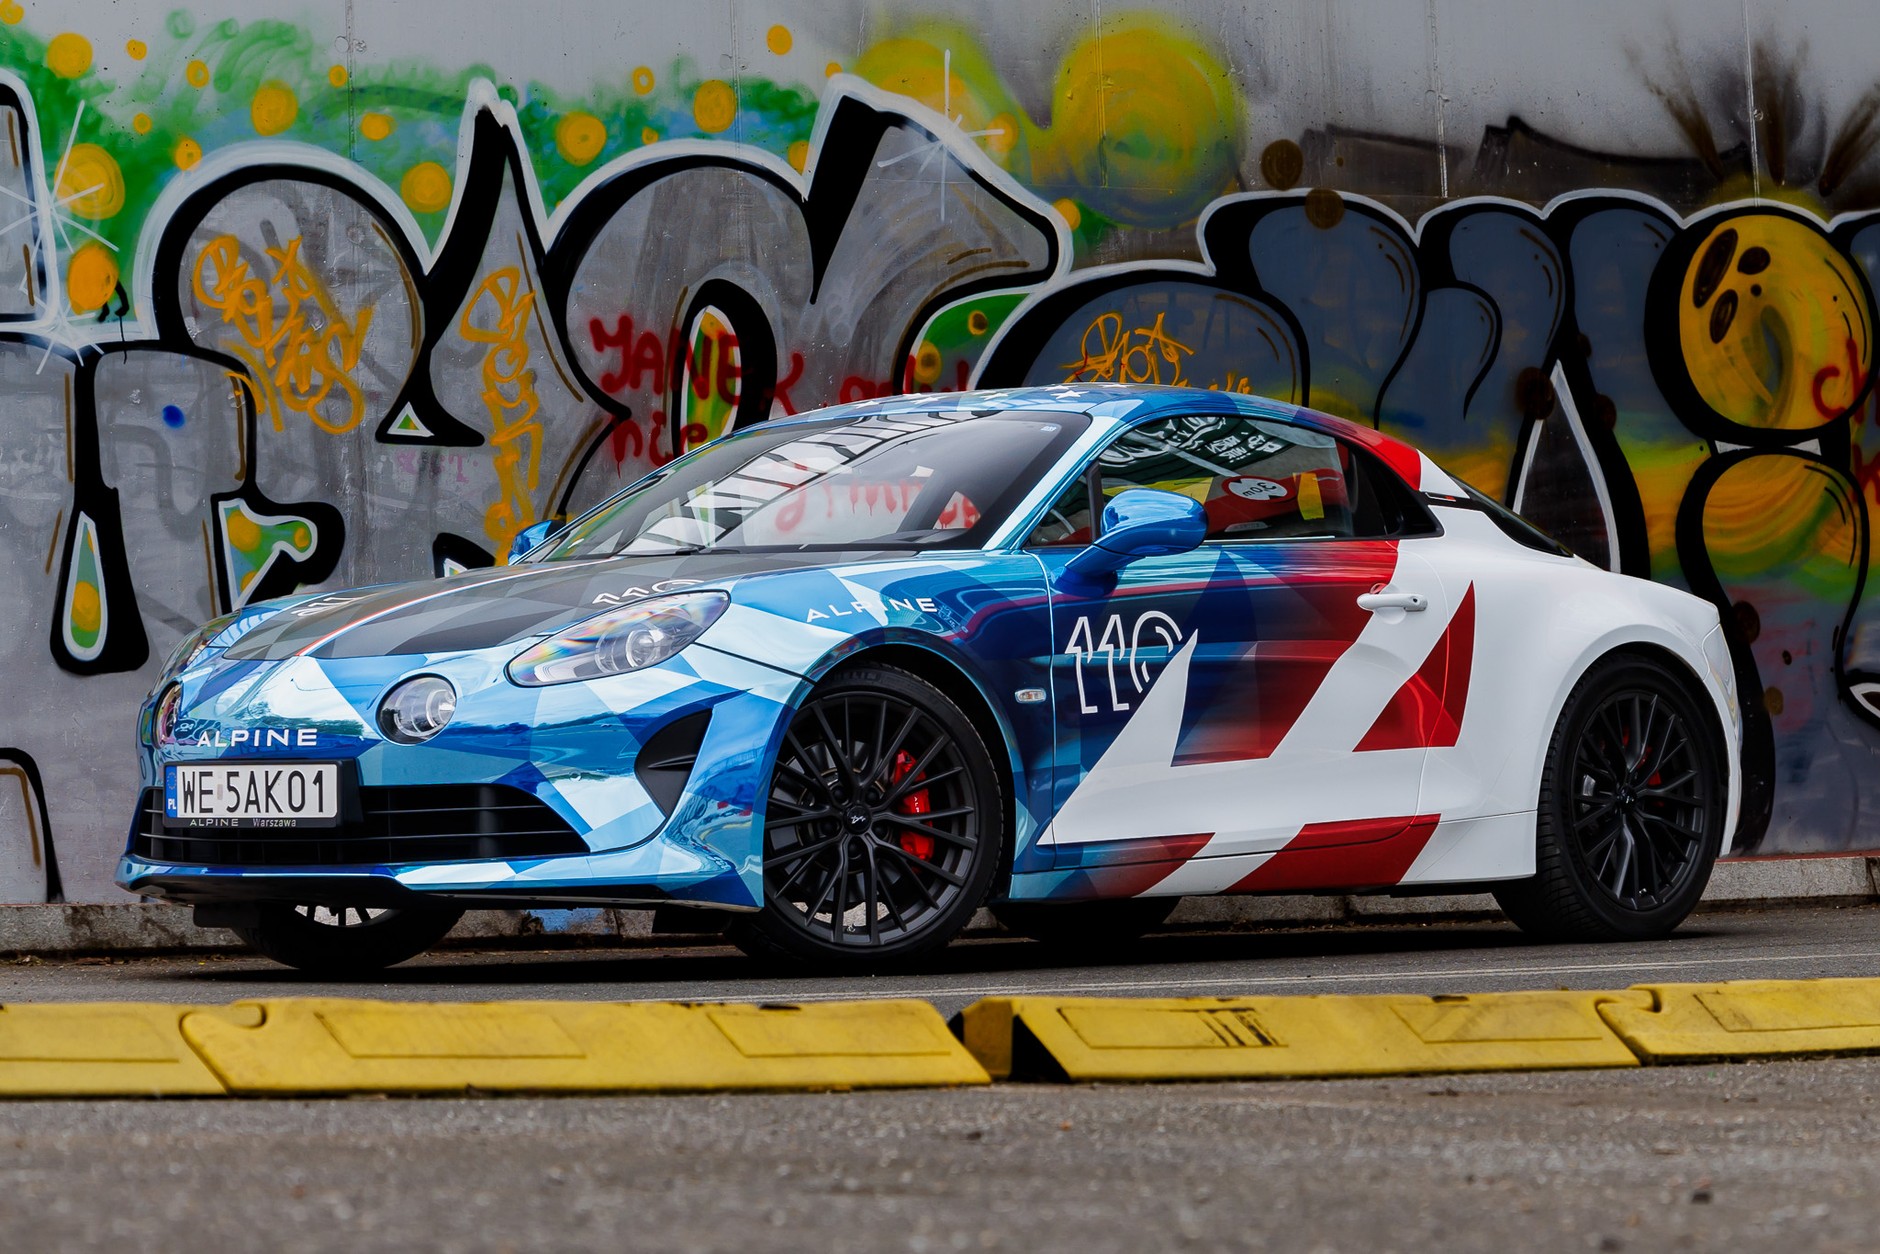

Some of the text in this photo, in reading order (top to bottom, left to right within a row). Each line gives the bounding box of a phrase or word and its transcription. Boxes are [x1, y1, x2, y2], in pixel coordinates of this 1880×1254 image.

[805, 597, 938, 624] ALPINE
[196, 728, 318, 748] ALPINE
[182, 770, 214, 814] WE
[168, 798, 176, 810] PL
[189, 818, 297, 828] ALPINE Warszawa
